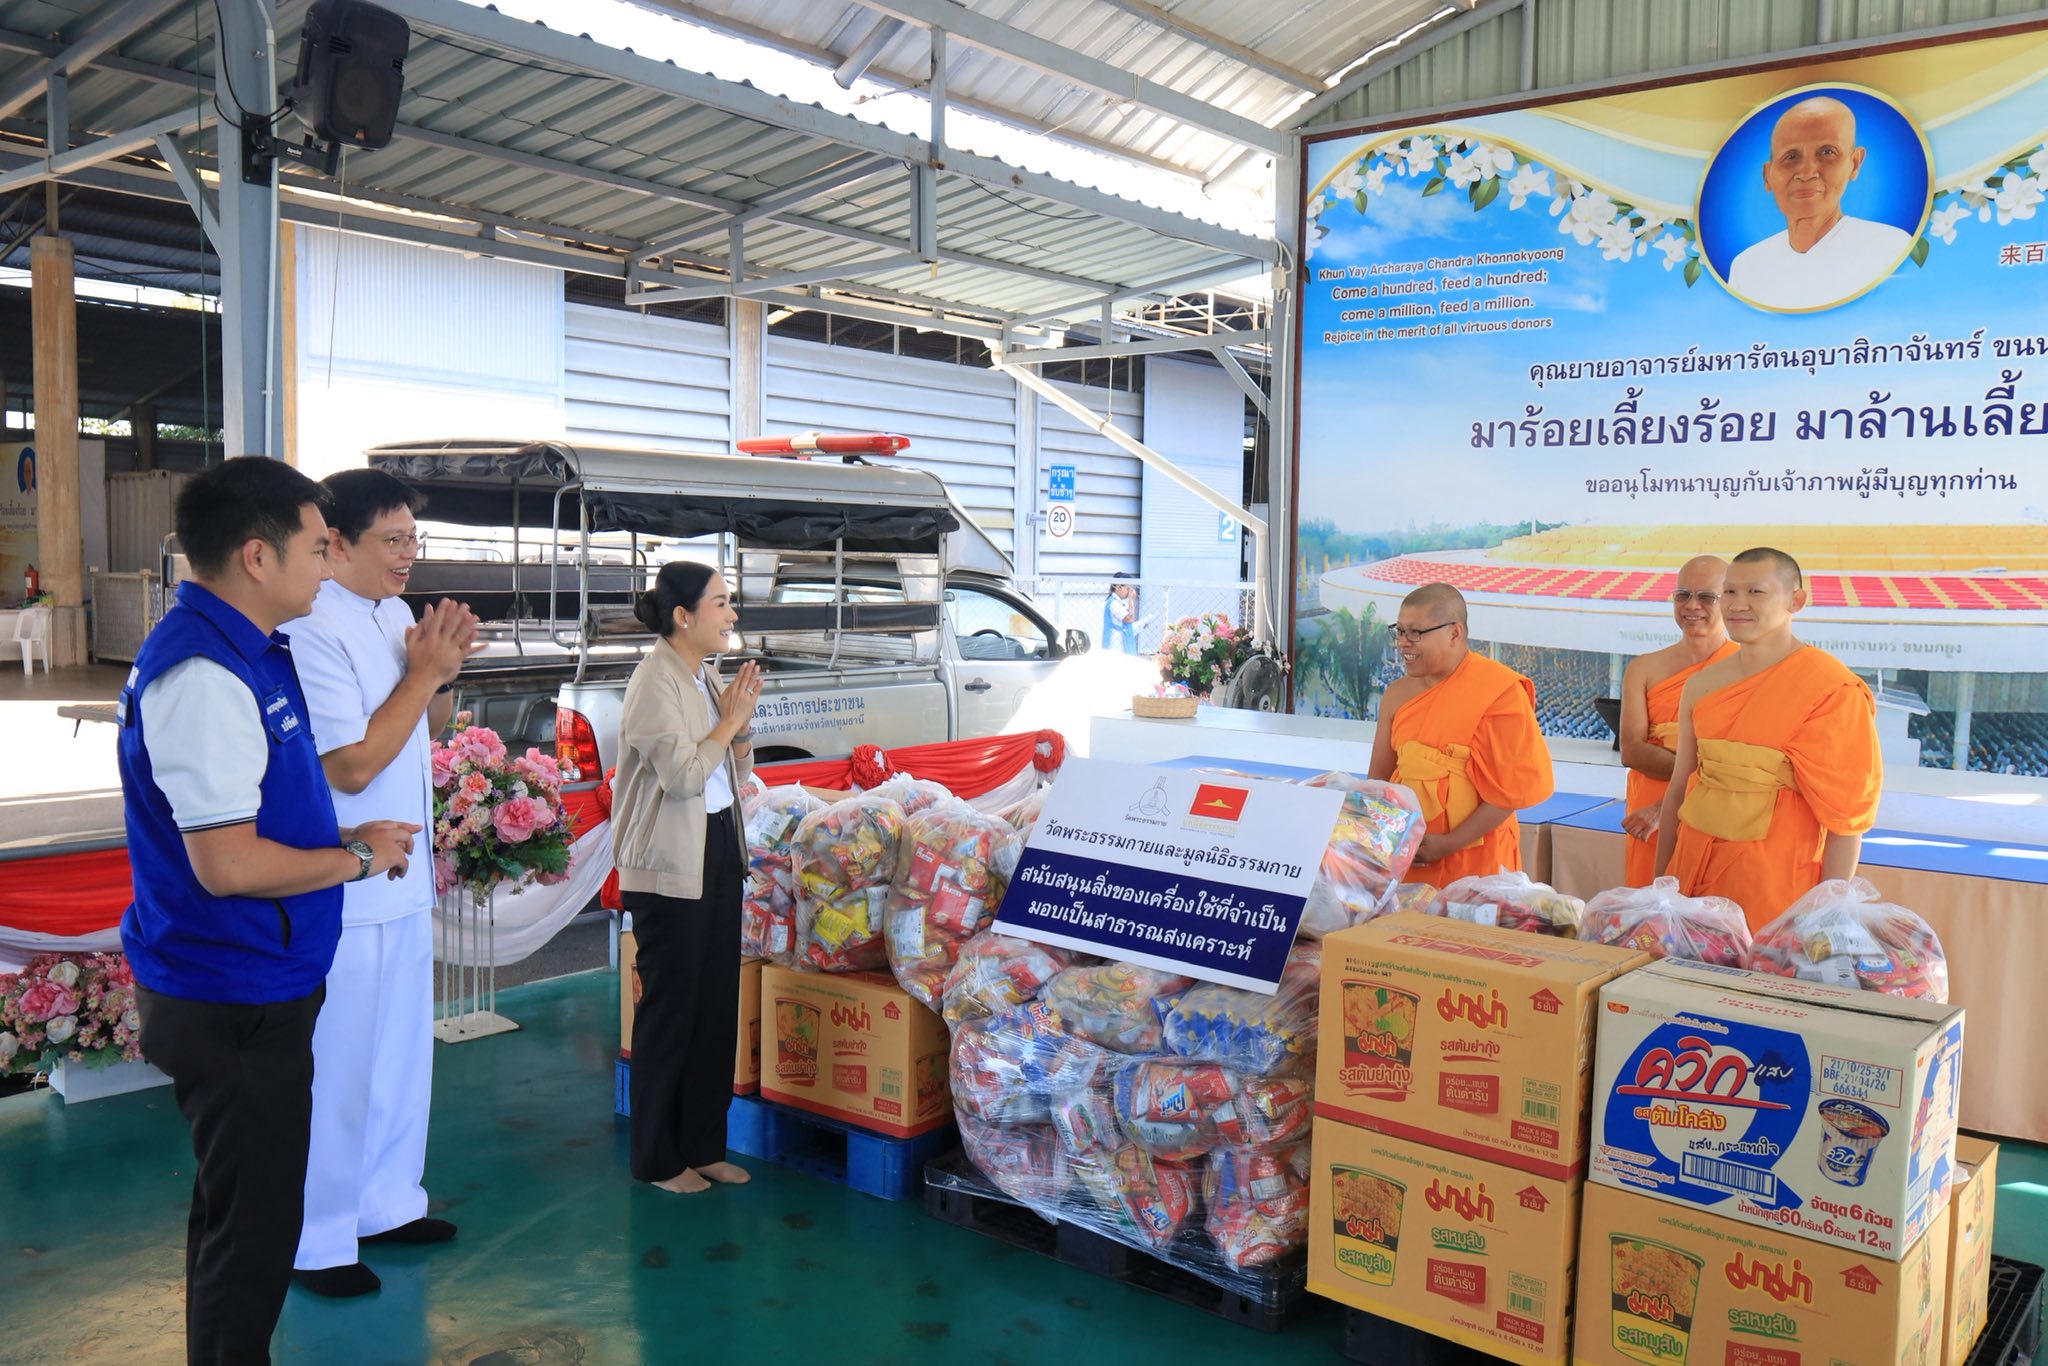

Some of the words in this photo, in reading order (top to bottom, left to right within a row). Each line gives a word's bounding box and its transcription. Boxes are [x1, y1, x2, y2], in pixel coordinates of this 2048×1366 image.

[1319, 269, 1345, 279] Khun
[1348, 266, 1367, 277] Yay
[1370, 261, 1424, 275] Archaraya
[1427, 256, 1473, 269] Chandra
[1476, 249, 1564, 265] Khonnokyoong
[1332, 287, 1367, 300] Come
[1371, 286, 1378, 296] a
[1442, 276, 1470, 290] feed
[1475, 276, 1482, 287] a
[1341, 309, 1374, 321] come
[1378, 307, 1385, 318] a
[1440, 300, 1468, 314] feed
[1473, 301, 1480, 311] a
[1324, 331, 1361, 344] Rejoice
[1364, 329, 1374, 339] in
[1377, 328, 1394, 339] the
[1397, 325, 1426, 337] merit
[1429, 324, 1441, 335] of
[1444, 323, 1457, 334] all
[1461, 322, 1507, 333] virtuous
[1511, 319, 1552, 330] donors
[1470, 387, 1778, 448] มาร้อยเลี้ยงร้อย
[1051, 468, 1074, 482] กรุณา
[1053, 511, 1067, 523] 20
[1221, 515, 1235, 540] 2
[1045, 818, 1302, 879] วัดพระธรรมกายและมูลนิธิธรรมกาย
[1020, 863, 1288, 933] สนับสนุนสิ่งของเครื่องใช้ที่จำเป็น
[1027, 898, 1258, 963] มอบเป็นสาธารณสงเคราะห์
[1437, 987, 1509, 1029] มาม่า
[1440, 1039, 1500, 1057] รสต้มยำกุ้ง
[1339, 1065, 1412, 1089] รสต้มยำกุ้ง
[1425, 1178, 1495, 1223] มาม่า
[1811, 1196, 1847, 1219] จัดชุด
[1850, 1204, 1862, 1220] 6
[1432, 1228, 1485, 1250] รสหมูสับ
[1340, 1248, 1391, 1273] รสหมูสับ
[1725, 1251, 1813, 1304] มาม่า
[1728, 1308, 1797, 1335] รสหมูสับ
[1618, 1325, 1682, 1356] รสหมูสับ
